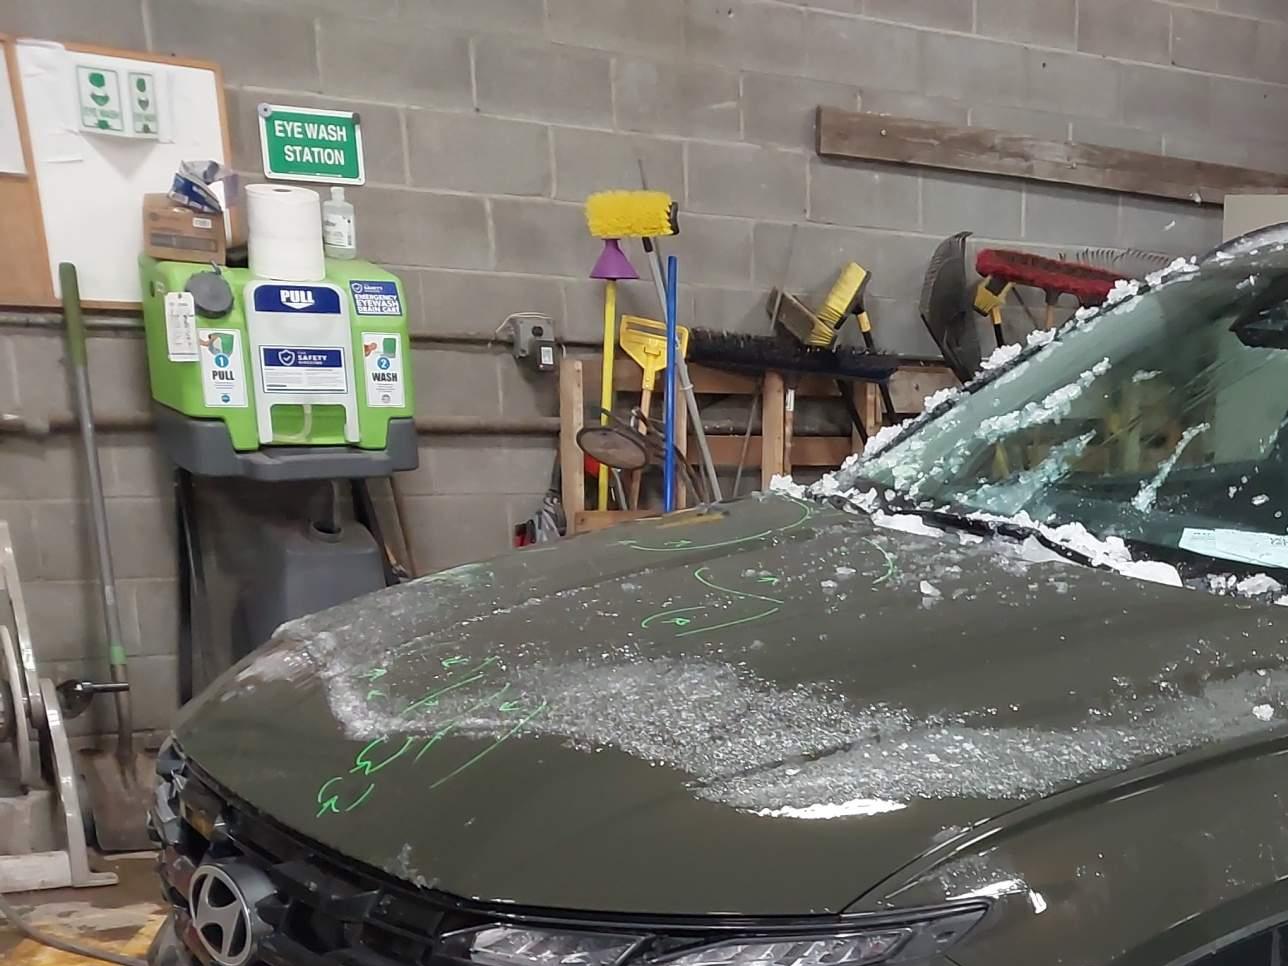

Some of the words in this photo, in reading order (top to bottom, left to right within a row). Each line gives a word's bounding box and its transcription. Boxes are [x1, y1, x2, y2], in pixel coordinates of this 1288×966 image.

[274, 120, 303, 138] EYE
[304, 123, 347, 142] WASH
[284, 145, 345, 165] STATION
[280, 289, 315, 304] PULL
[212, 370, 234, 381] PULL
[371, 372, 398, 382] WASH
